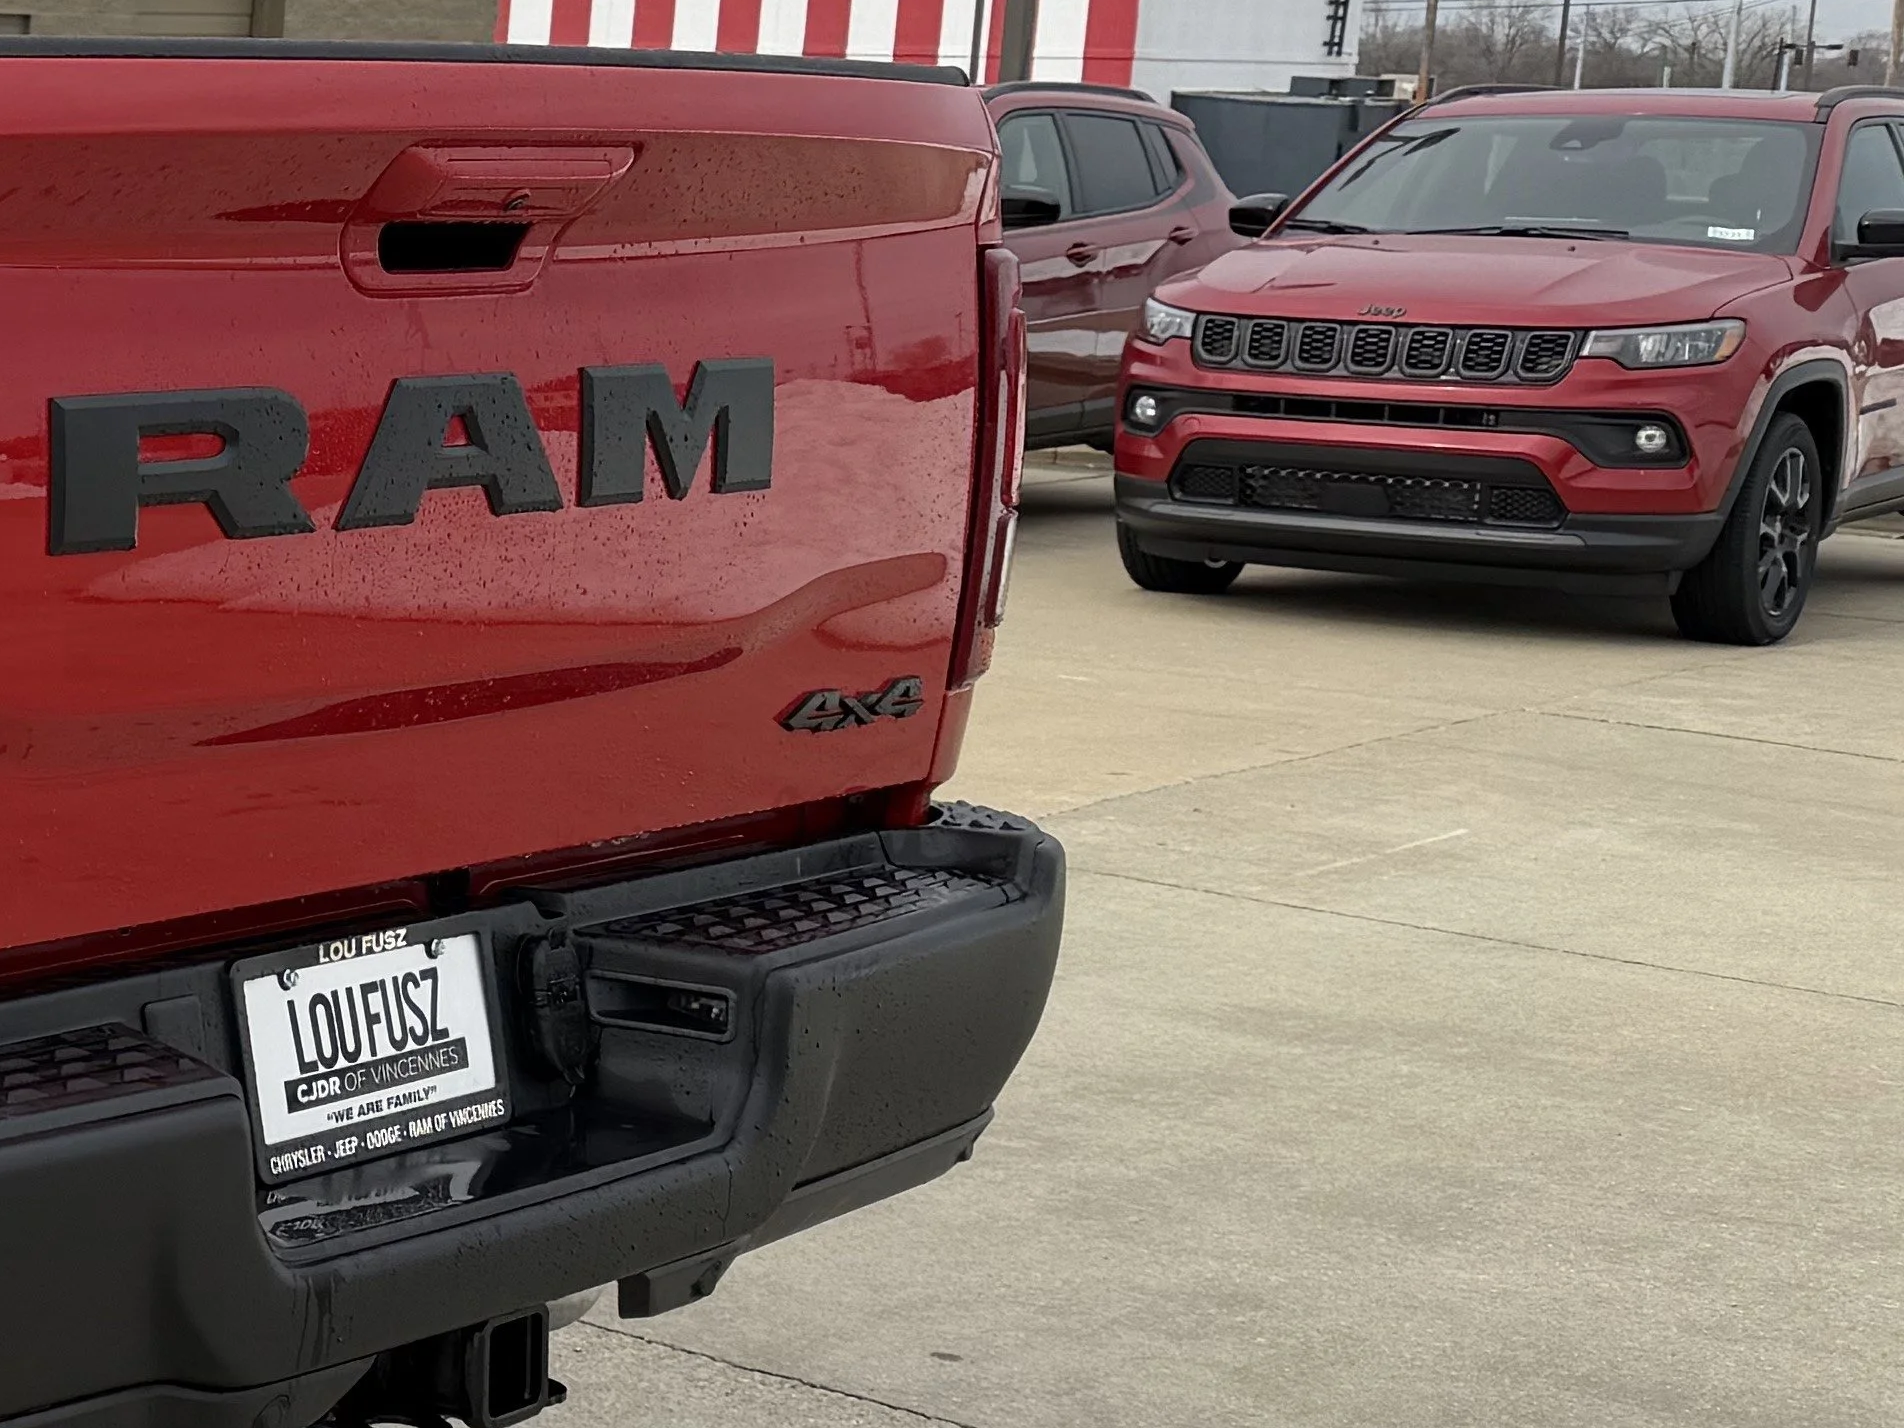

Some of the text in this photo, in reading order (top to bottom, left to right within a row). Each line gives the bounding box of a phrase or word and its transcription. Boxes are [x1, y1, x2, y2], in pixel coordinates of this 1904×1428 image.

[46, 357, 775, 555] RAM
[319, 928, 407, 963] LOU FUSZ
[296, 1047, 459, 1104] CJDR OF VINCENNES
[357, 1099, 383, 1117] ARE
[270, 1145, 325, 1175] CHRYSLER
[333, 1136, 358, 1158] JEEP
[366, 1125, 402, 1149] DODGE
[409, 1115, 432, 1138] RAM
[434, 1114, 448, 1132] OF
